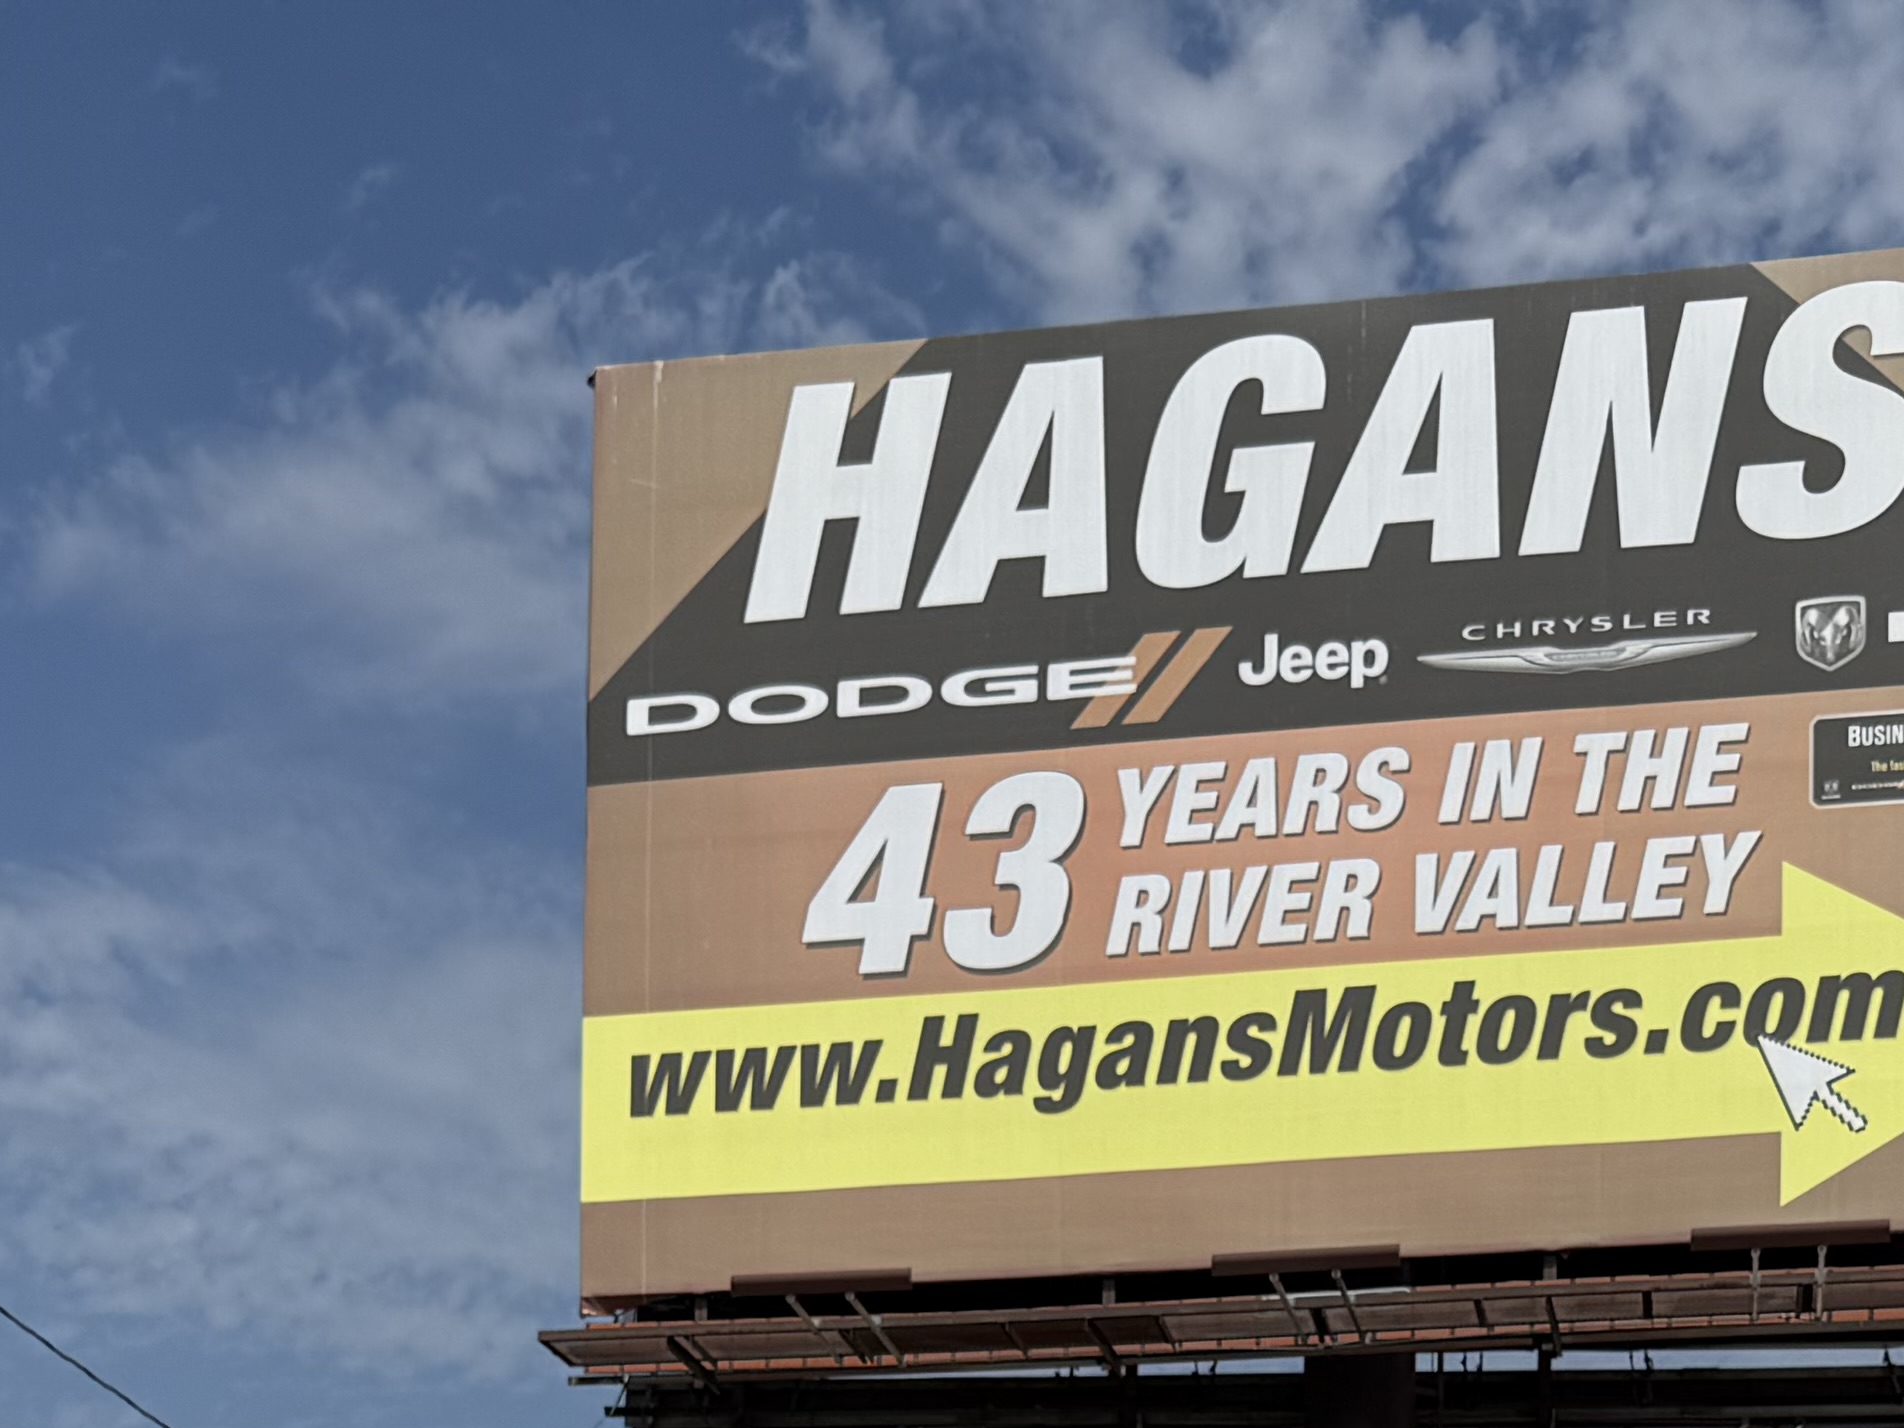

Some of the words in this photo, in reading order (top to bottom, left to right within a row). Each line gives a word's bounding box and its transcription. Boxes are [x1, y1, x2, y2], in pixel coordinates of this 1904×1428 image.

[1238, 633, 1389, 689] Jeep
[1461, 608, 1711, 641] CHRYSLER
[626, 655, 1138, 736] DODGE
[1115, 745, 1411, 849] YEARS
[1437, 736, 1543, 824] IN
[1571, 722, 1751, 815] THE
[801, 769, 1086, 976] 43
[1105, 857, 1381, 959] RIVER
[1412, 830, 1763, 935] VALLEY
